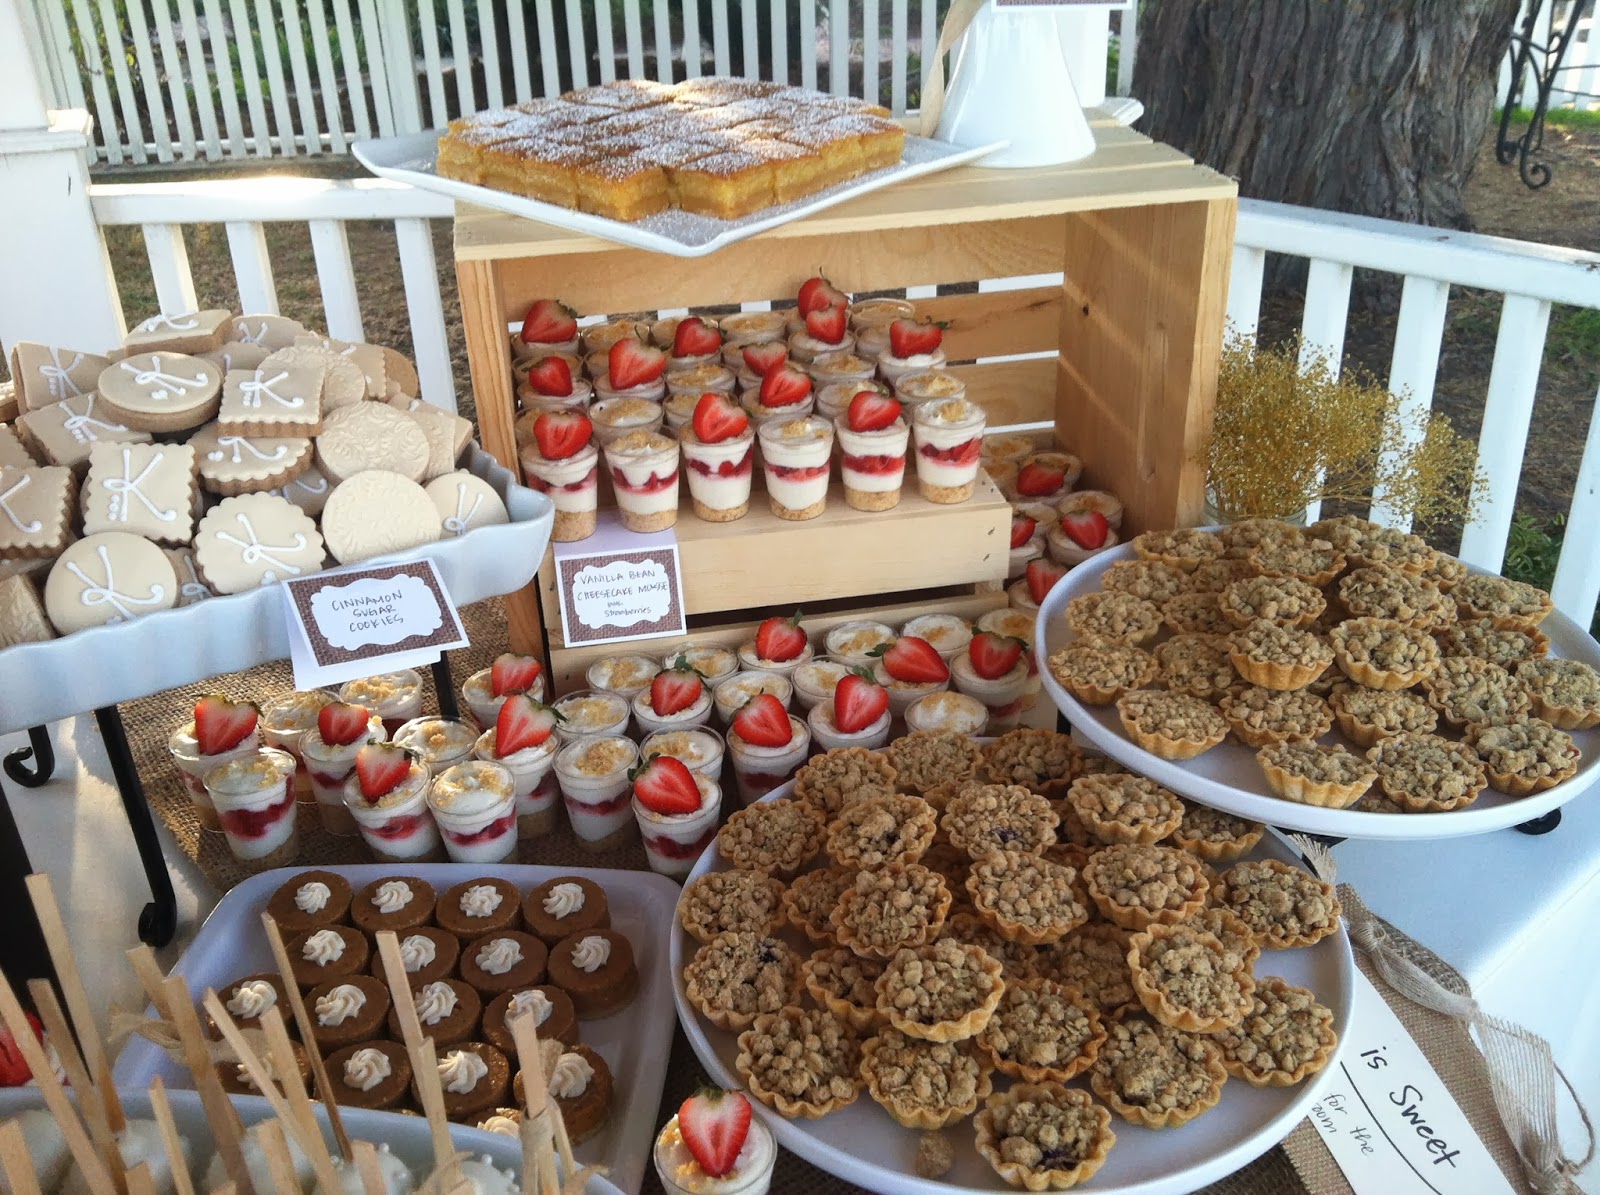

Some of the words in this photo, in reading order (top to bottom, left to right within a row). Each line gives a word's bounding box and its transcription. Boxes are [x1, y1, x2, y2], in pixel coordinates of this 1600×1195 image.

[240, 369, 304, 408] K
[103, 448, 177, 522] K
[215, 512, 307, 575] K
[66, 545, 164, 621] K
[577, 586, 633, 601] CHEESECAKE
[580, 572, 624, 585] VANILLA
[628, 570, 656, 580] BEAN
[331, 589, 403, 611] CINNAMON
[352, 604, 397, 618] SUGAR
[349, 614, 404, 632] COOKIES
[1323, 1093, 1347, 1115] for
[1350, 1126, 1374, 1156] the
[1360, 1046, 1388, 1070] is
[1389, 1084, 1461, 1168] Sweet
